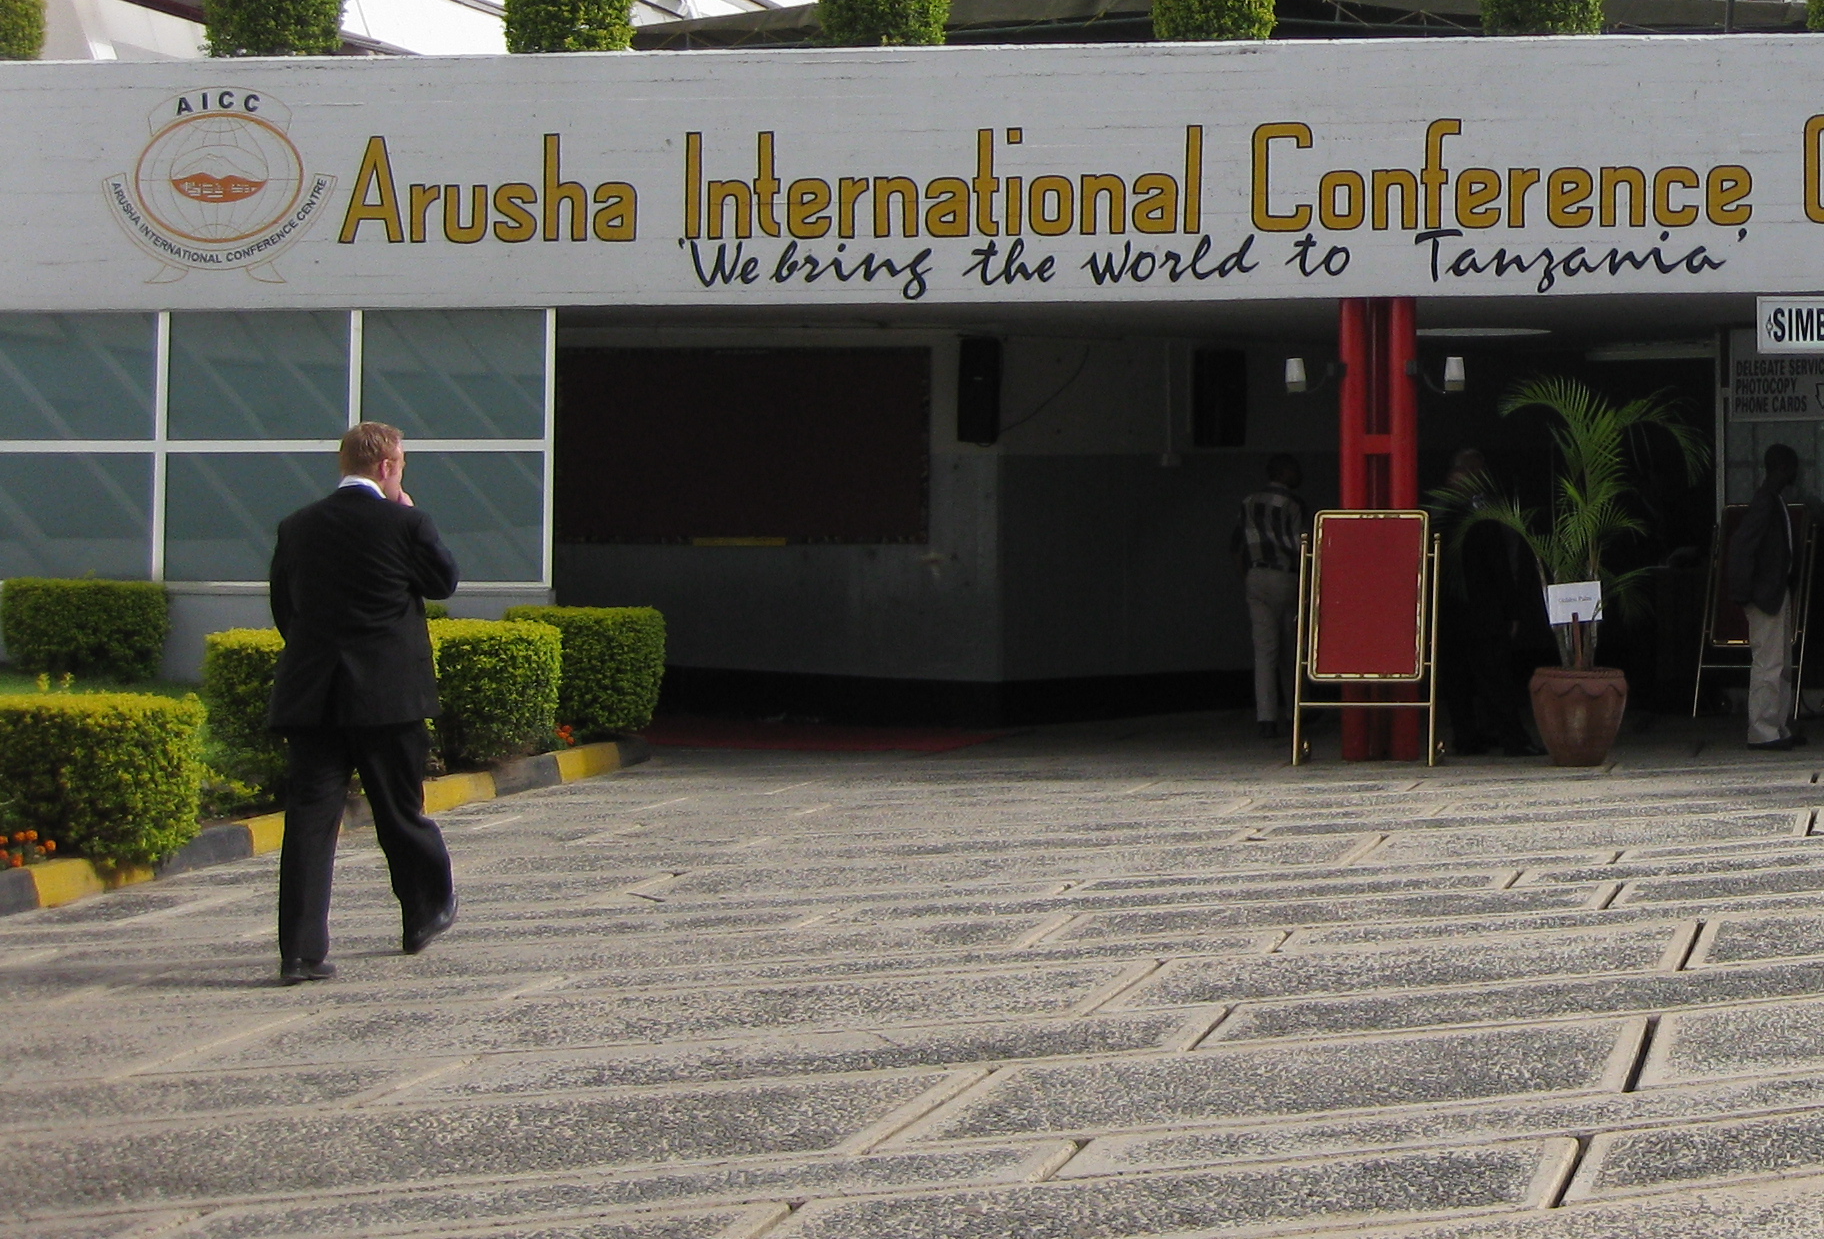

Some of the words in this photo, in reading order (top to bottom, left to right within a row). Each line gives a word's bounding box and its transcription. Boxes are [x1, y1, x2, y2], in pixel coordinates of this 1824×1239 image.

[176, 90, 261, 116] AICC
[337, 132, 638, 245] Arusha
[684, 124, 1204, 240] International
[1250, 118, 1754, 233] Conference
[112, 181, 141, 225] ARUSHA
[139, 221, 223, 264] INTERNATIONAL
[225, 225, 297, 262] CONFERENCE
[296, 178, 328, 222] CENTRE
[769, 243, 934, 300] bring
[962, 237, 1057, 285] the
[1081, 234, 1259, 284] world
[1284, 231, 1352, 277] to
[1736, 359, 1785, 377] DELEGATE
[1735, 377, 1797, 395] PHOTOCOPY
[1735, 396, 1769, 413] PHONE
[1771, 395, 1807, 412] CARDS
